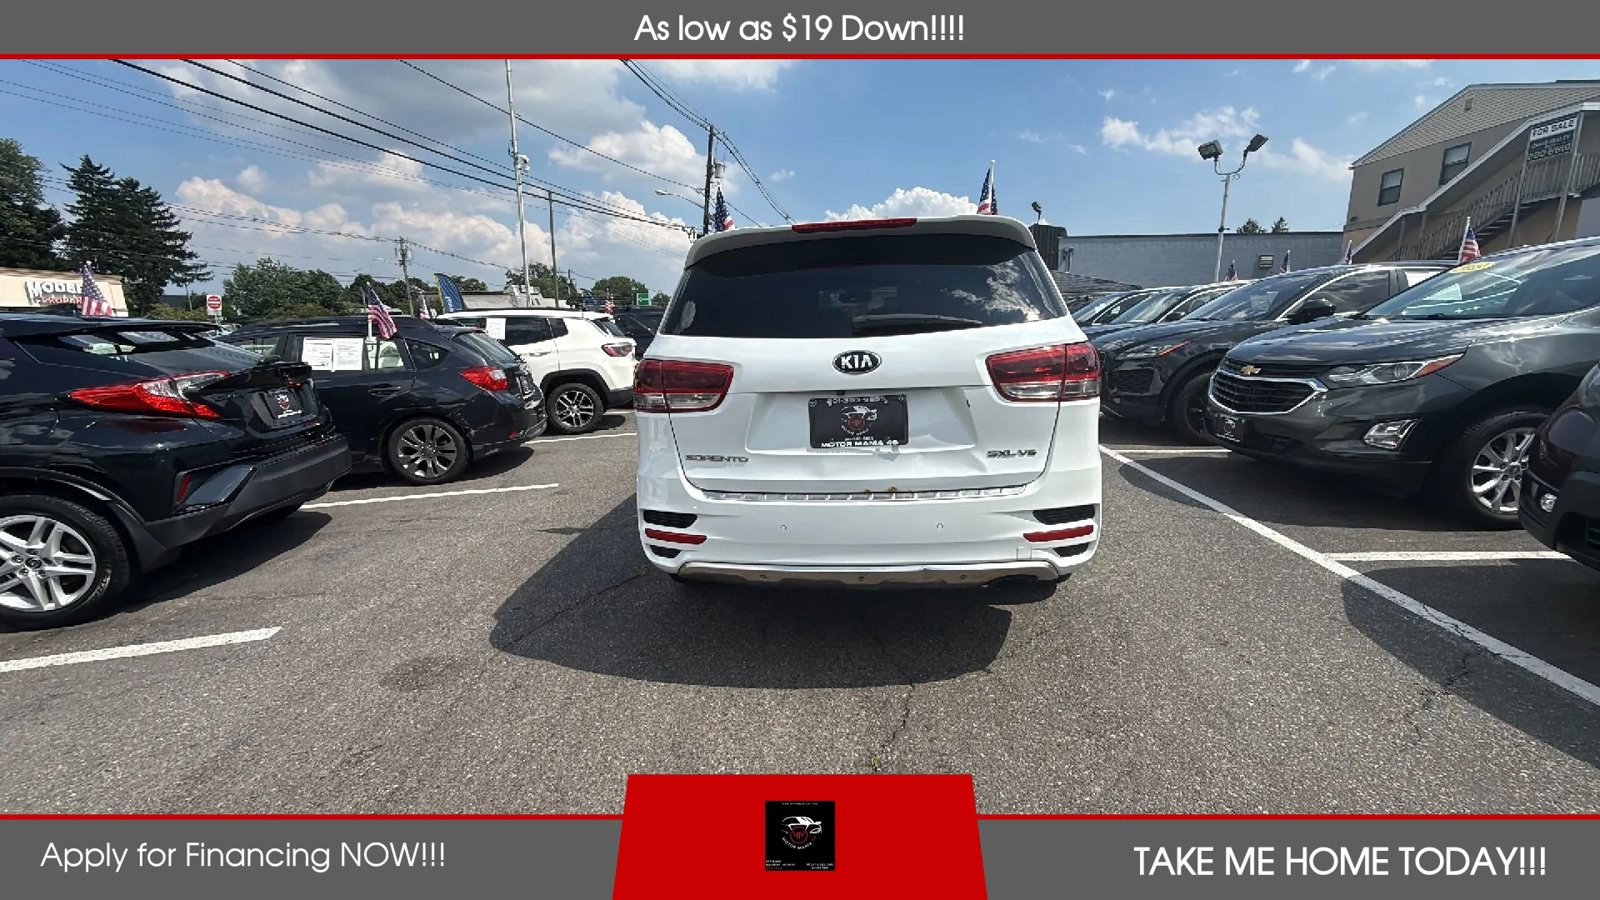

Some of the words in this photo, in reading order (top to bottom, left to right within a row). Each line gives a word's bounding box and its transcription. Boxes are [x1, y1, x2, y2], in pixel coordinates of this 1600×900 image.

[1532, 126, 1549, 137] FOR
[1551, 119, 1574, 132] SALE
[840, 354, 873, 369] KIA
[685, 455, 749, 463] SORENTO
